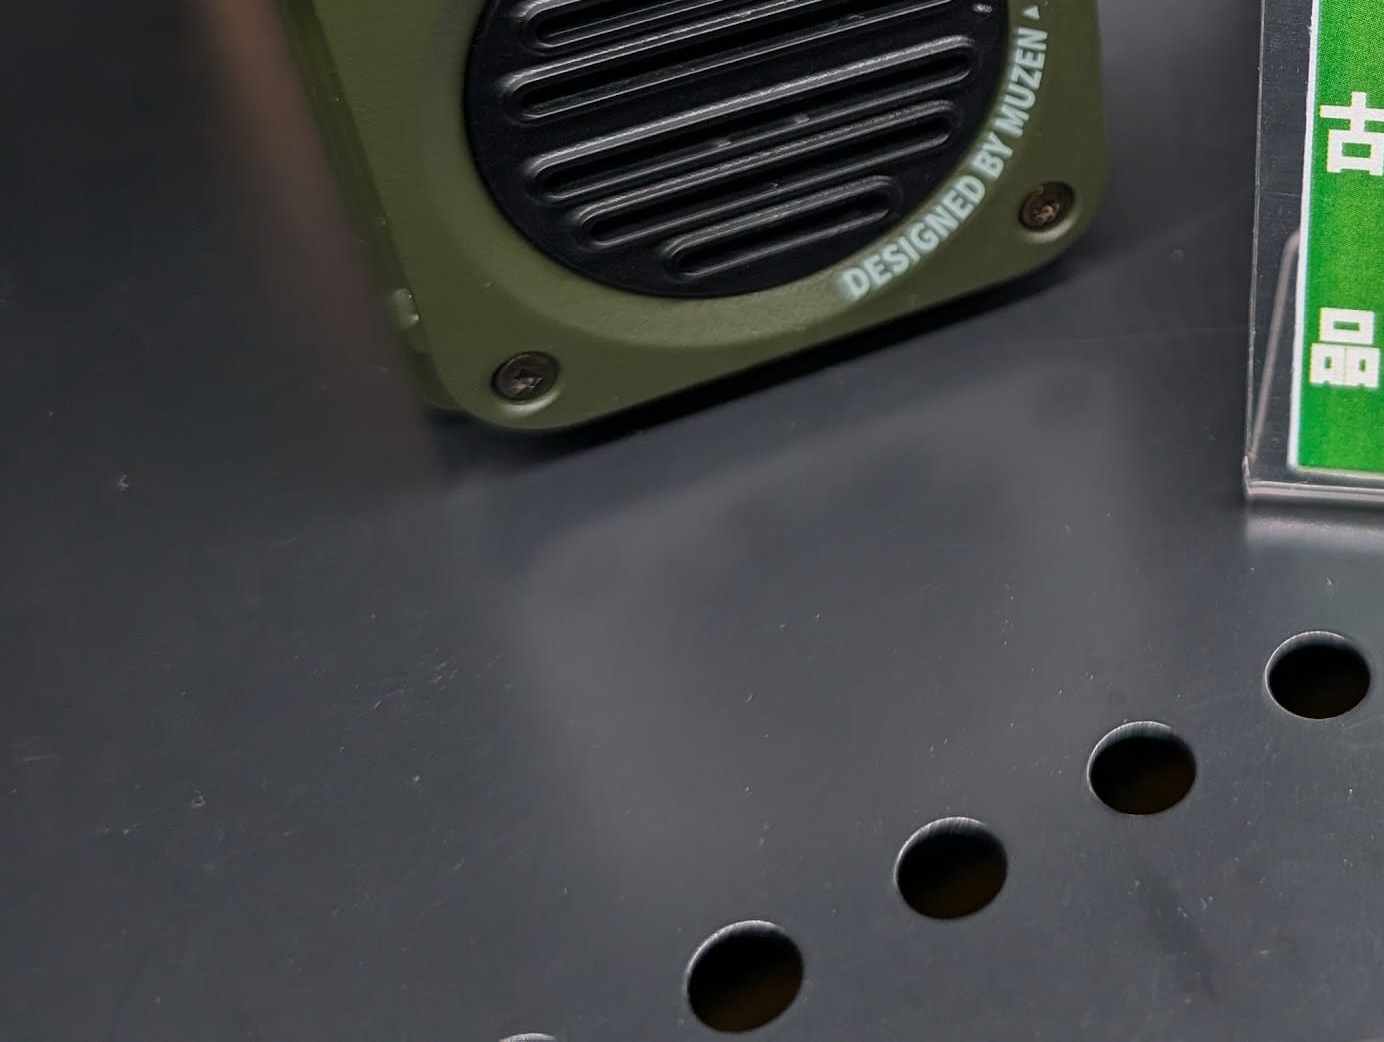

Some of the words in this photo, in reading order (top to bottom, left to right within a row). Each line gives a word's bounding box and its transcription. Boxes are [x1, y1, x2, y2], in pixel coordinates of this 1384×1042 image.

[842, 175, 985, 302] DESIGNED
[972, 132, 1014, 179] BY
[993, 26, 1048, 138] MUZEN
